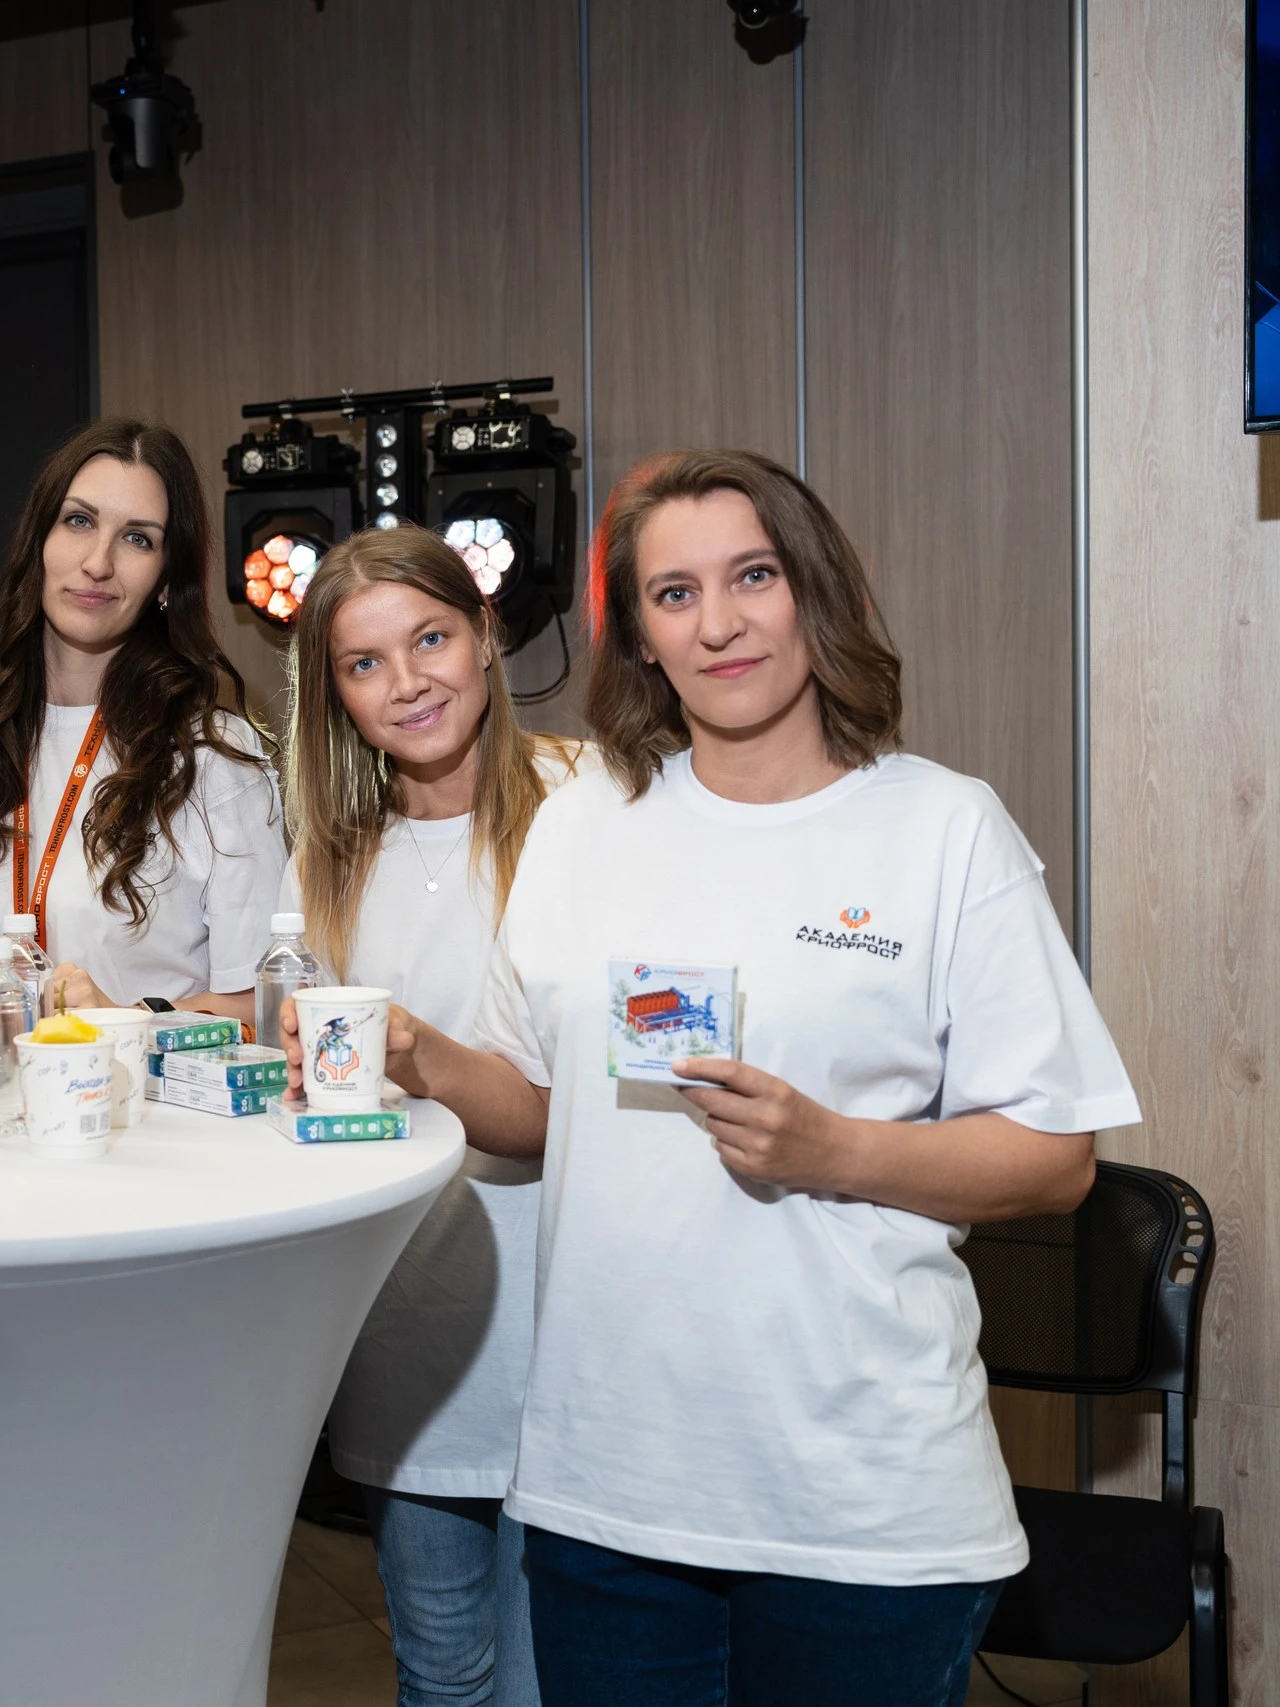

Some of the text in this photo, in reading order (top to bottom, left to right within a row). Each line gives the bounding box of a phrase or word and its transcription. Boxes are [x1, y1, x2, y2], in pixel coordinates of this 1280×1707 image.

[49, 784, 79, 853] TEHNOFROST.COM
[795, 932, 900, 960] КРИОФРОСТ
[799, 925, 902, 952] АКАДЕМИЯ
